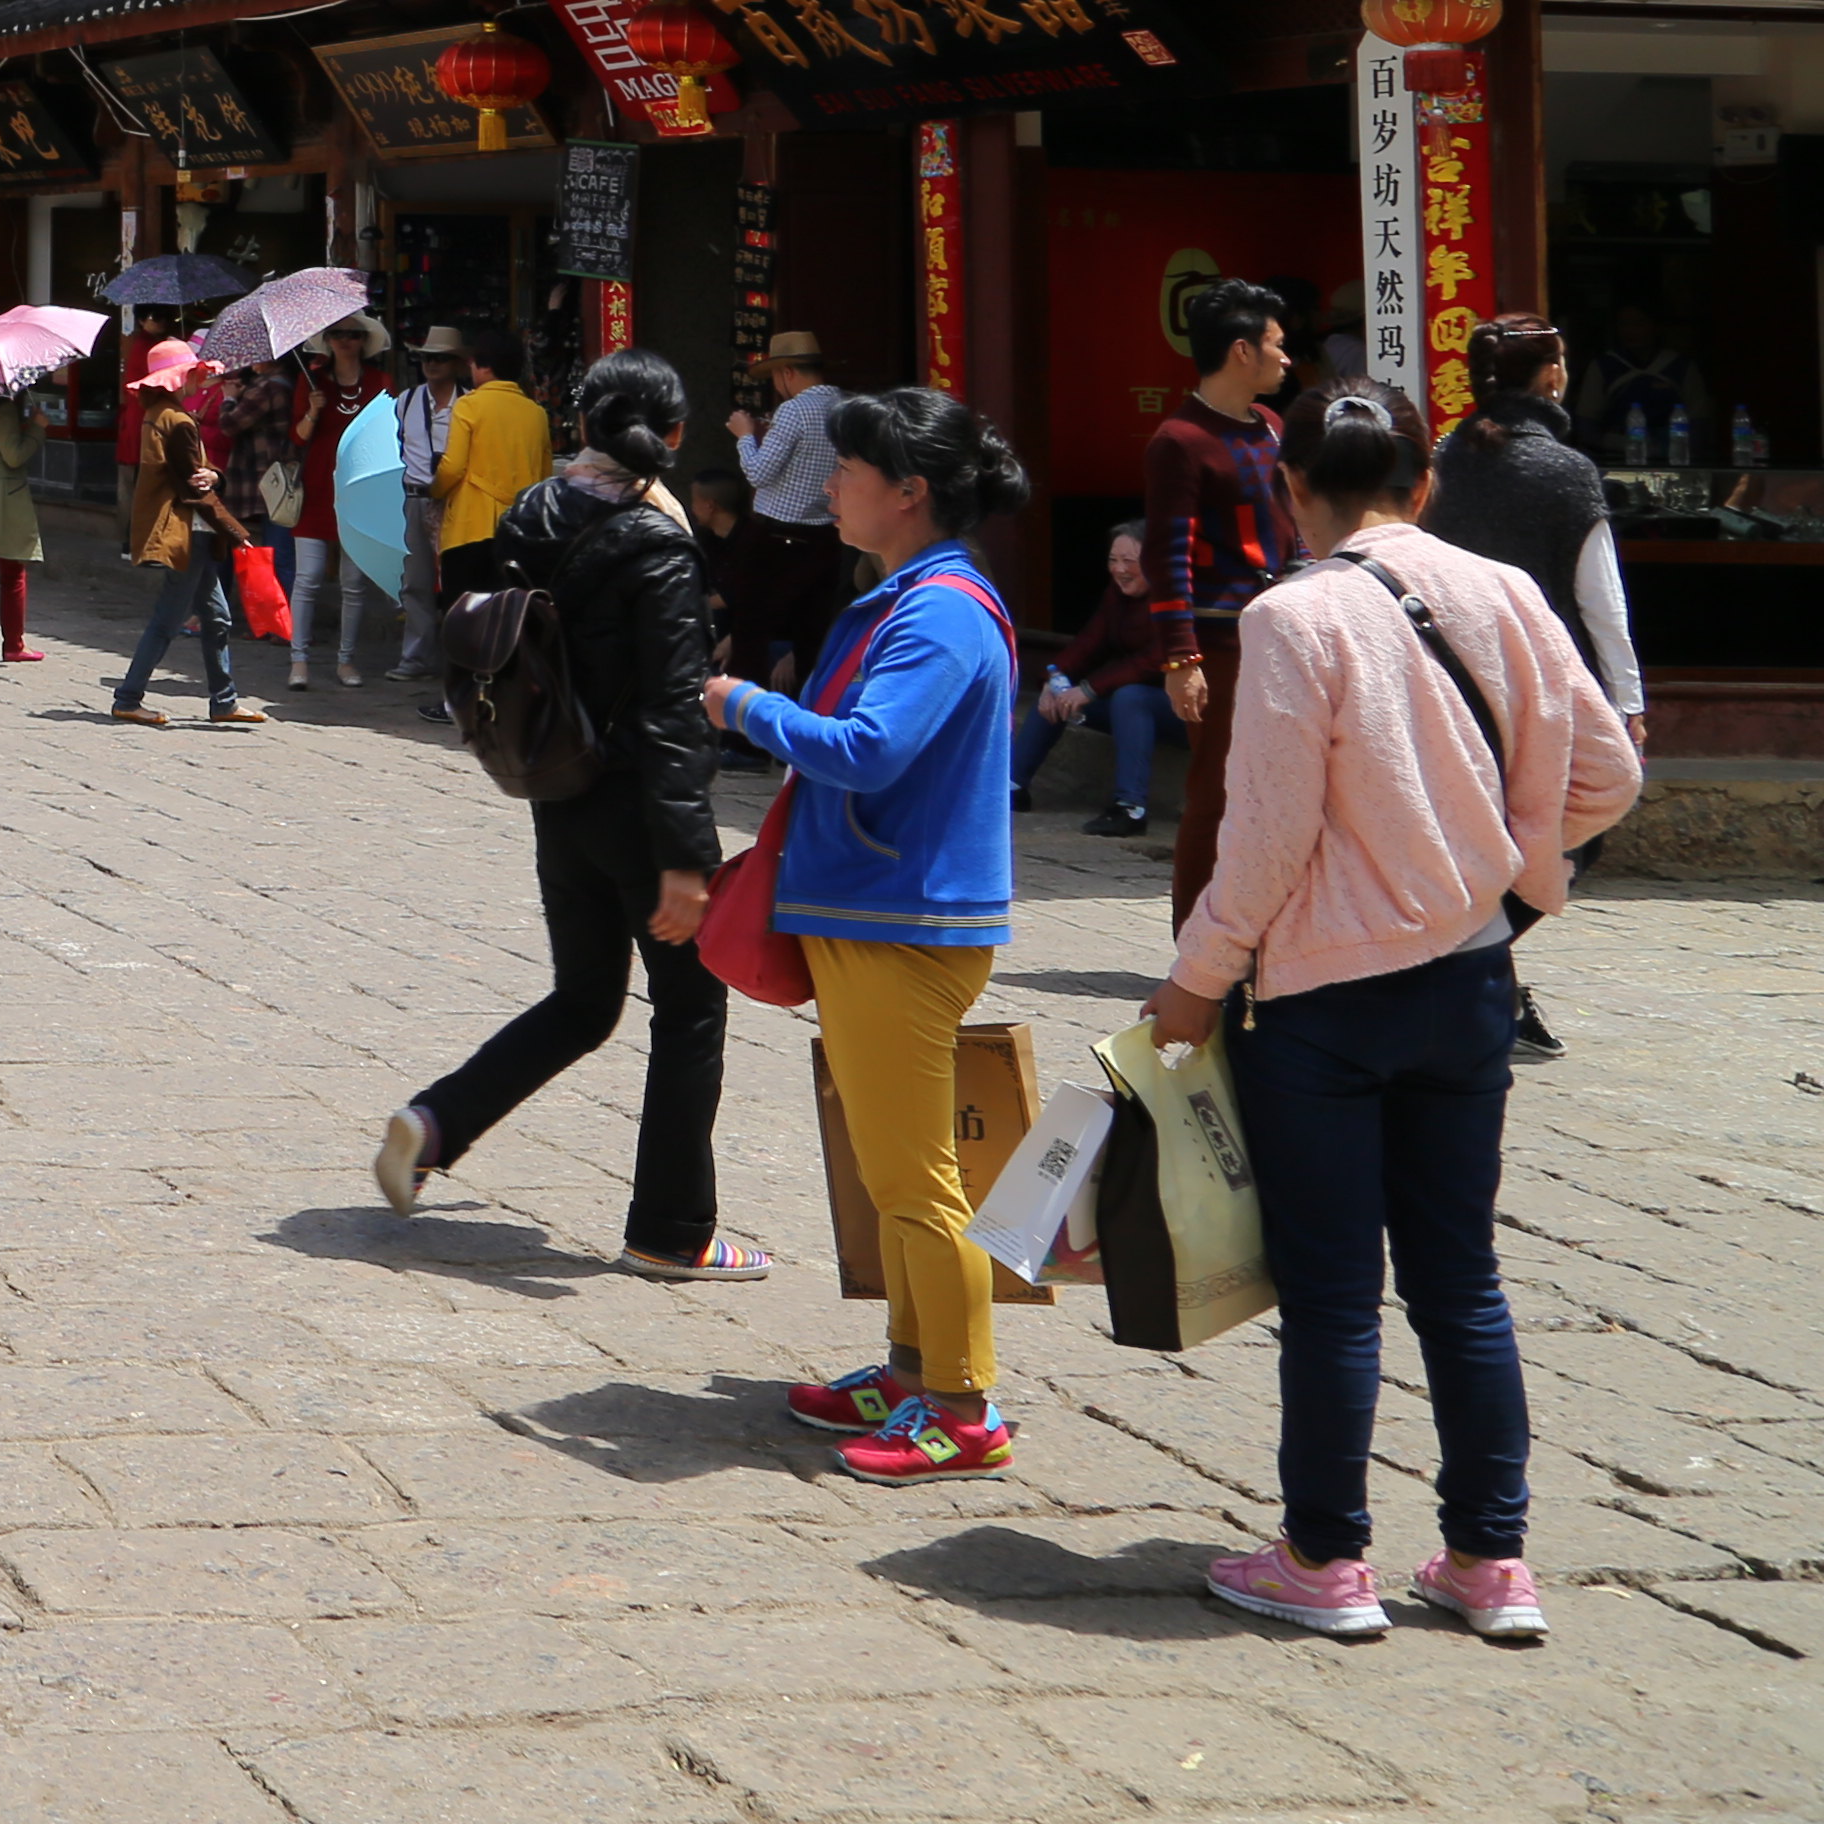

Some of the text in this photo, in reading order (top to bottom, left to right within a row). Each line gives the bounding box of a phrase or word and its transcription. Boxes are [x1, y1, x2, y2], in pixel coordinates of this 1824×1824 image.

[893, 79, 966, 106] FANG
[959, 63, 1121, 101] SILVERWARE
[578, 174, 619, 194] CAFE
[1368, 55, 1406, 393] 百岁坊天然玛
[1421, 136, 1478, 442] 吉祥年四季
